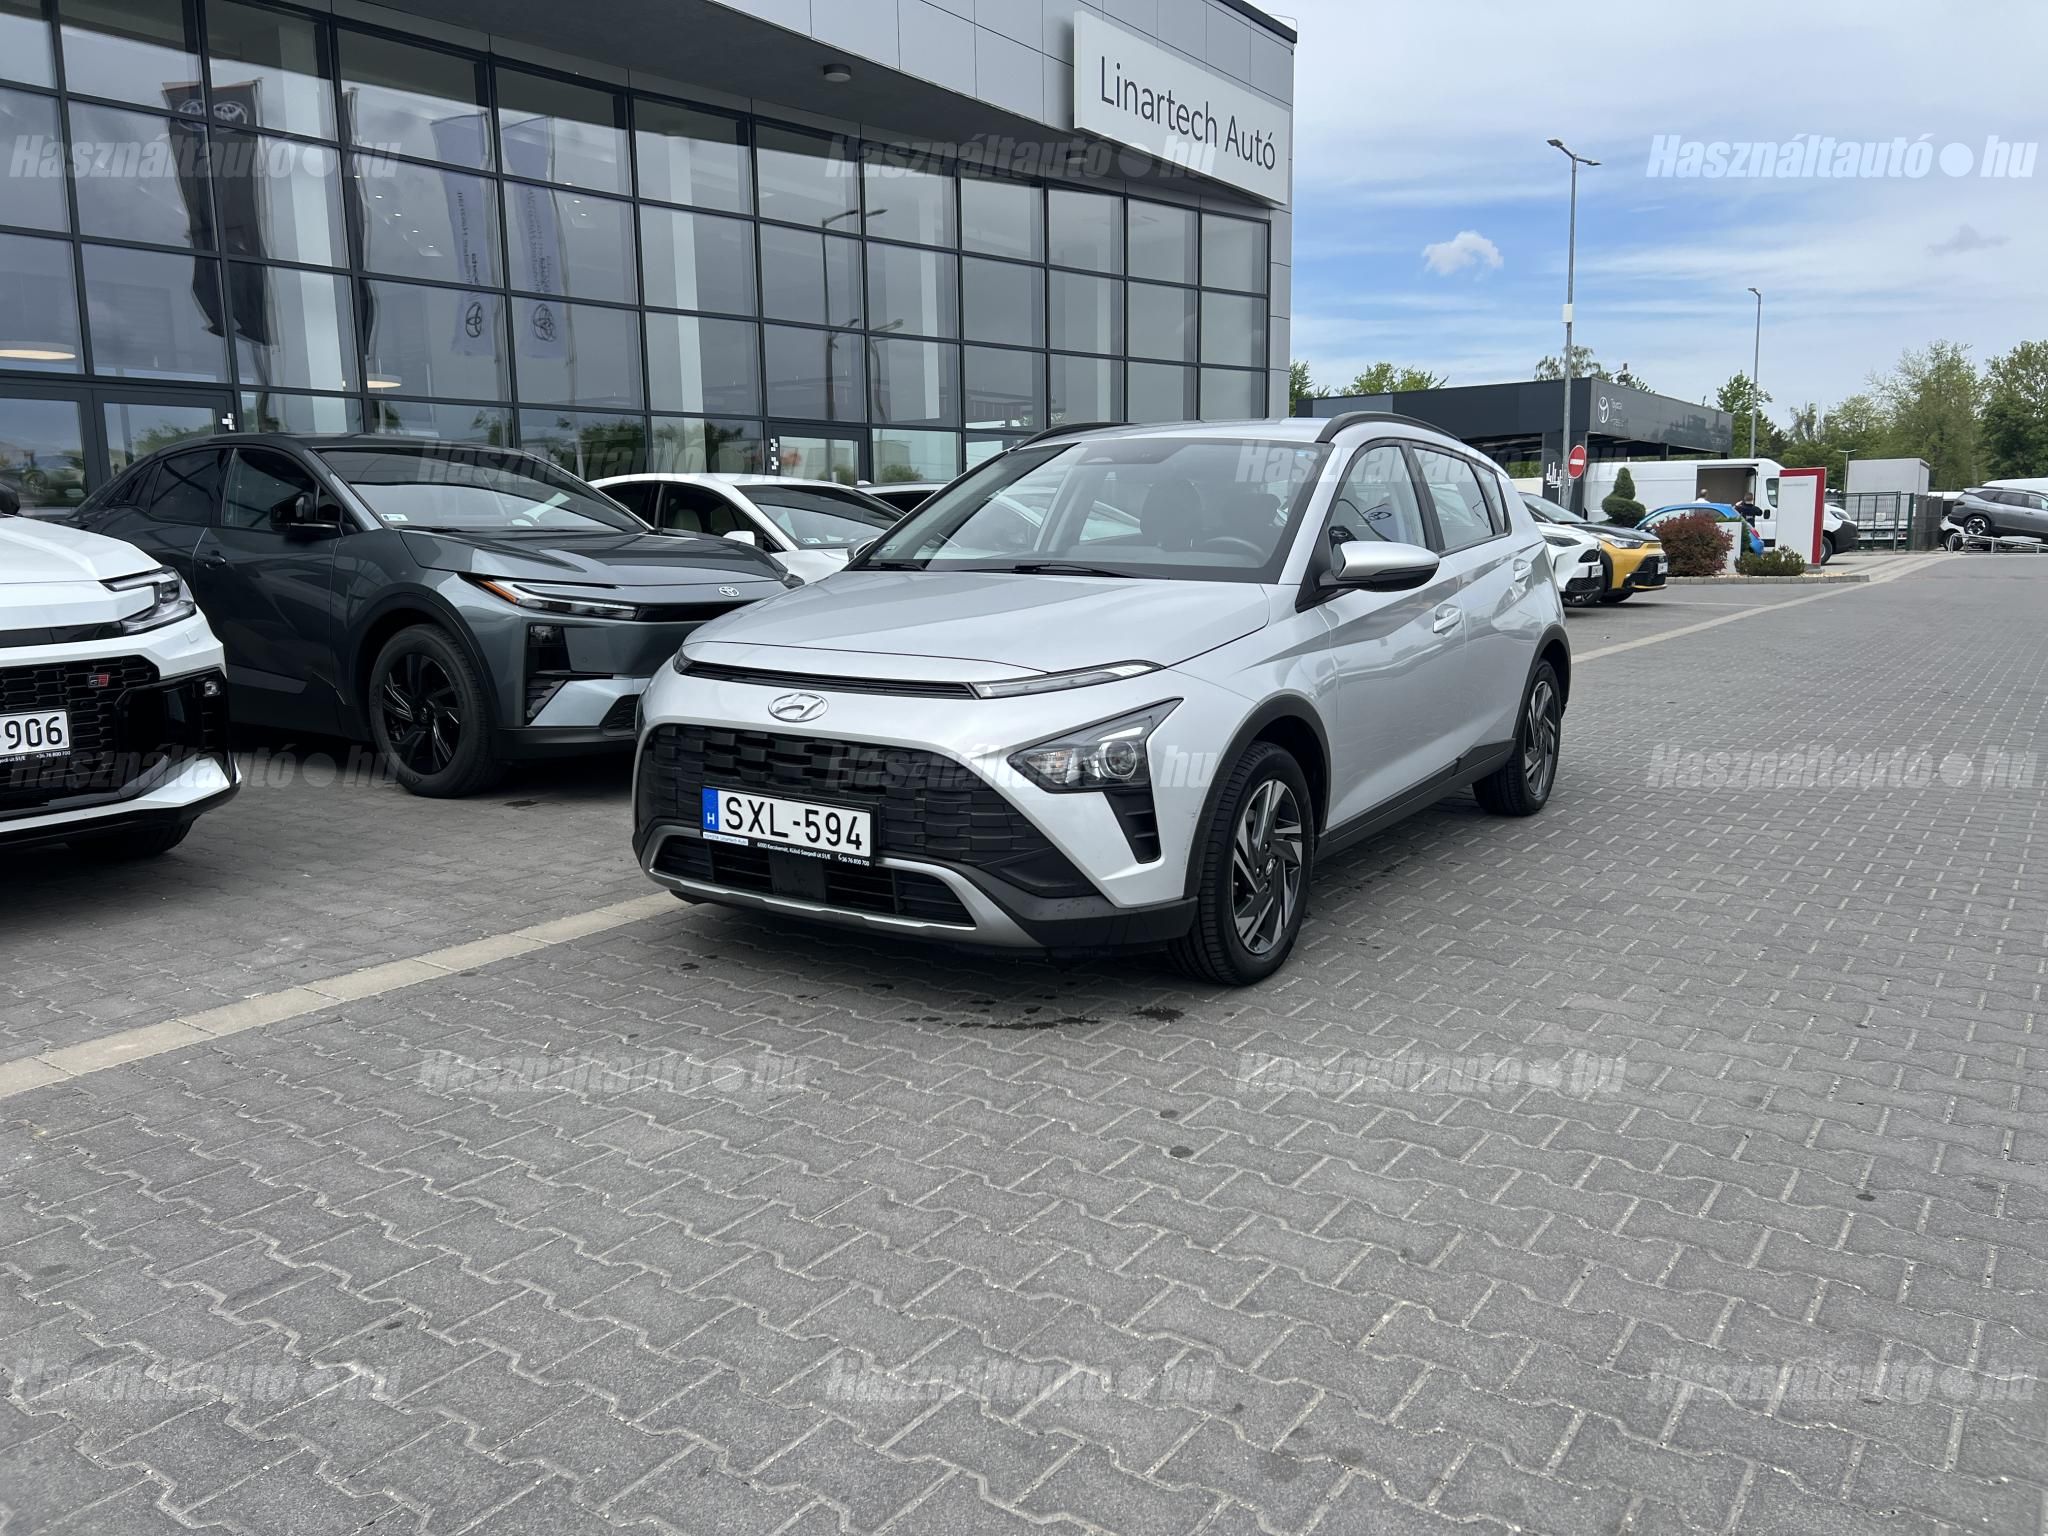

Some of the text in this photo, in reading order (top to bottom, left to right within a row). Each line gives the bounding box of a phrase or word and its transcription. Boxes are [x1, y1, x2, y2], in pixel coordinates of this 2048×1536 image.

[1101, 55, 1276, 170] Linartech Autó
[0, 716, 63, 750] 906
[706, 812, 716, 825] H
[725, 796, 863, 850] SXL-594
